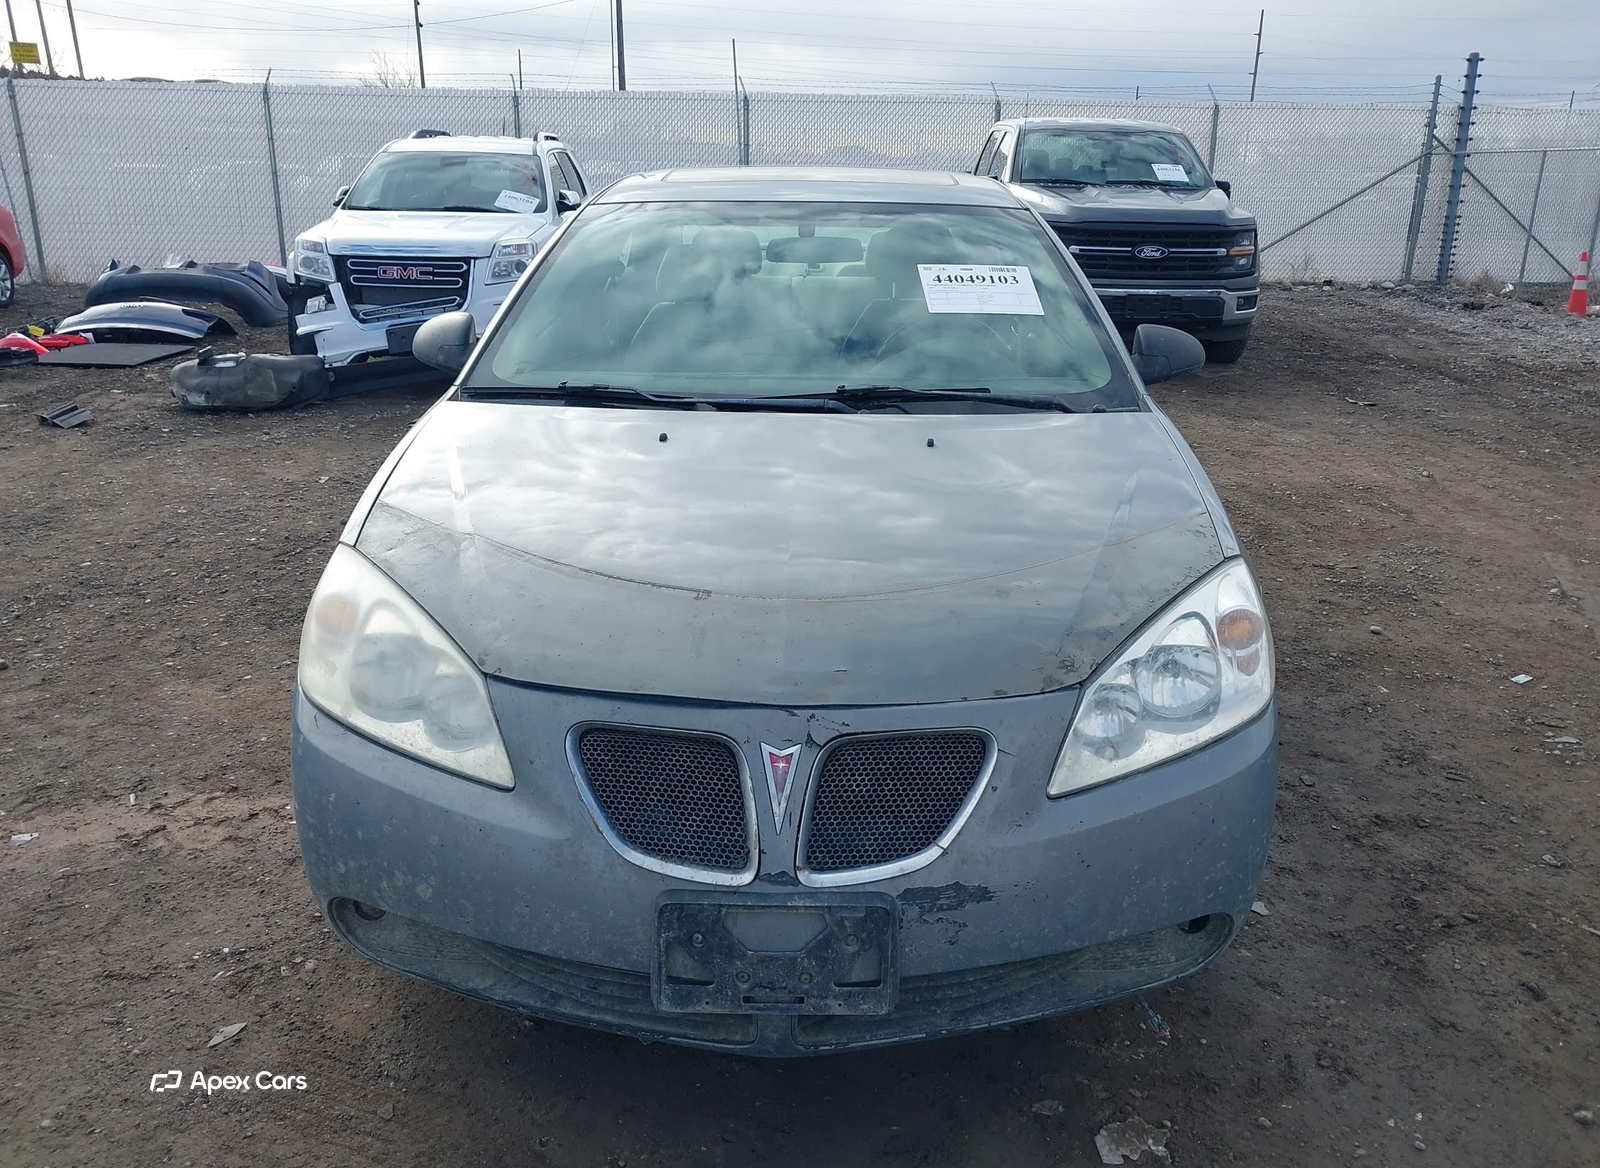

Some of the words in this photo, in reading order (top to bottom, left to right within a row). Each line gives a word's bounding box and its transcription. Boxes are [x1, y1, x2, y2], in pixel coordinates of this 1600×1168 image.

[1140, 247, 1162, 257] Ford
[377, 265, 434, 280] GMC
[932, 274, 1019, 285] 44049103
